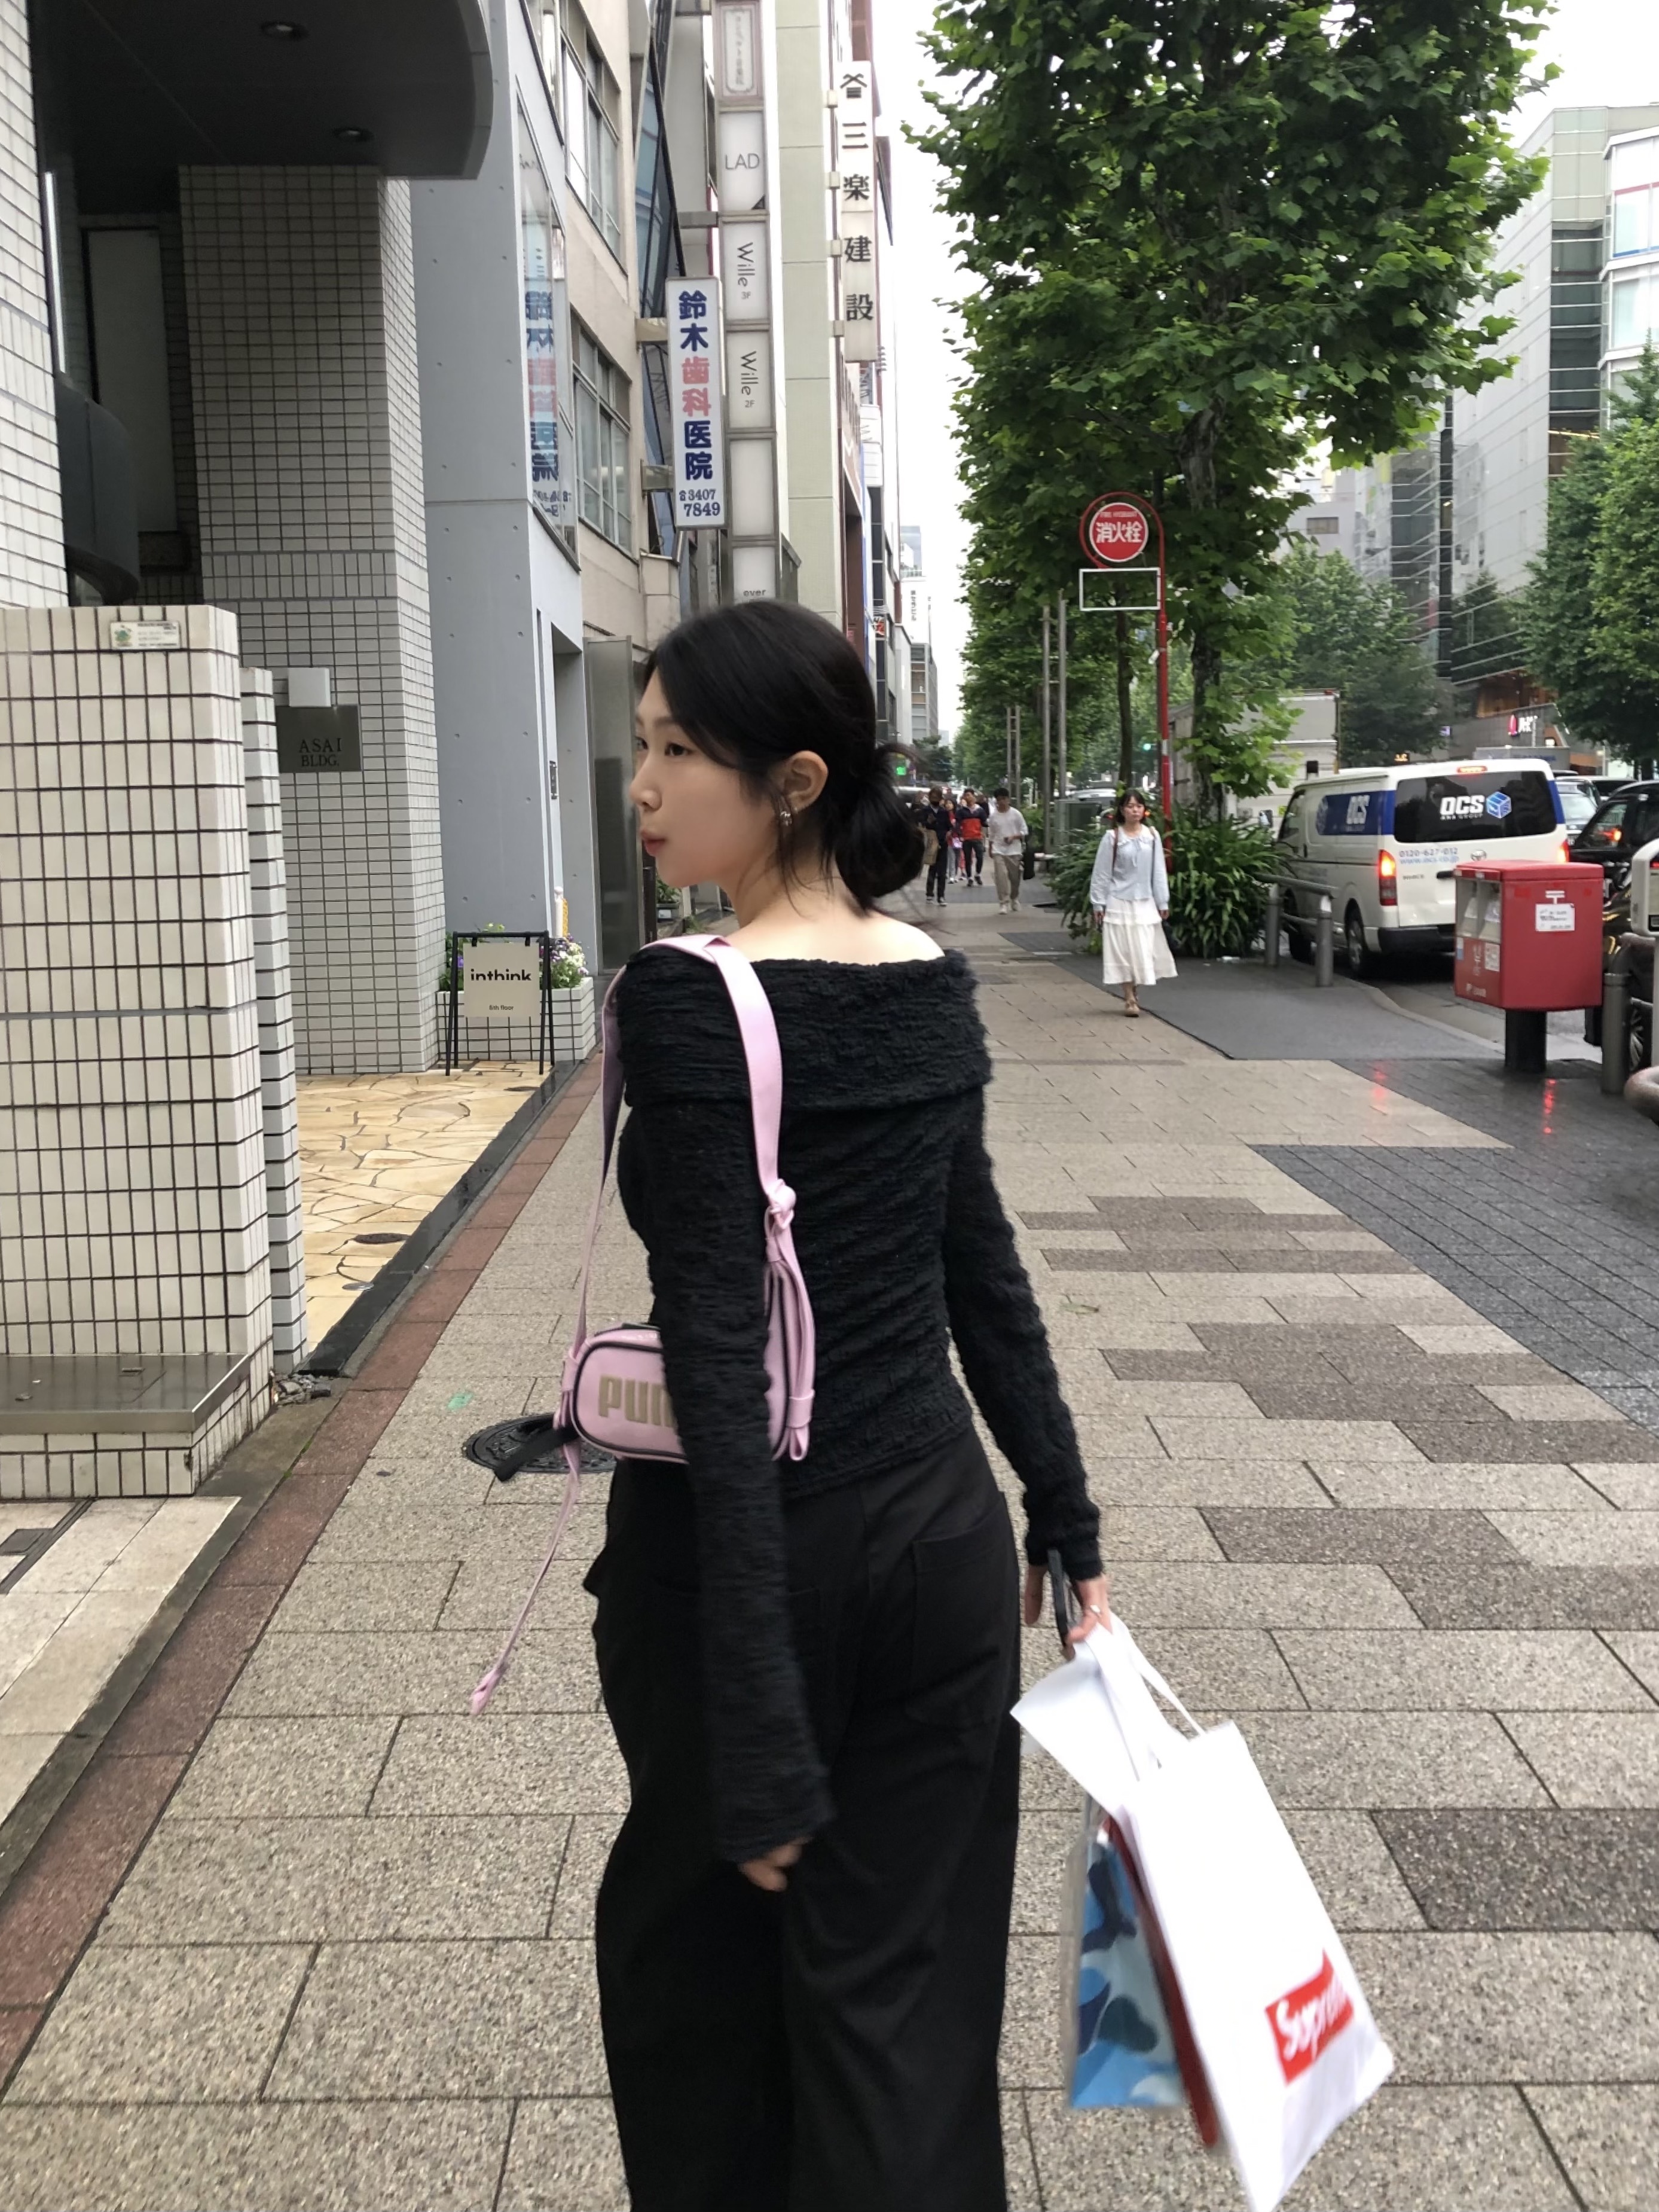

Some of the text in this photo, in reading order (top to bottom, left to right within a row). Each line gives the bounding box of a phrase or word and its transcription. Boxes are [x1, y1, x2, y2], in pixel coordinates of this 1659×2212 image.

[725, 152, 760, 170] LAD
[737, 242, 756, 287] Wille
[679, 289, 713, 481] 鈴木歯科医院
[740, 350, 759, 408] Wille 2F
[688, 489, 717, 501] 3407
[683, 502, 721, 517] 7849
[1095, 520, 1144, 543] 消火栓
[299, 737, 343, 753] ASAI
[301, 753, 340, 767] BLDG.
[1440, 794, 1485, 815] OCS
[470, 968, 532, 981] inthink
